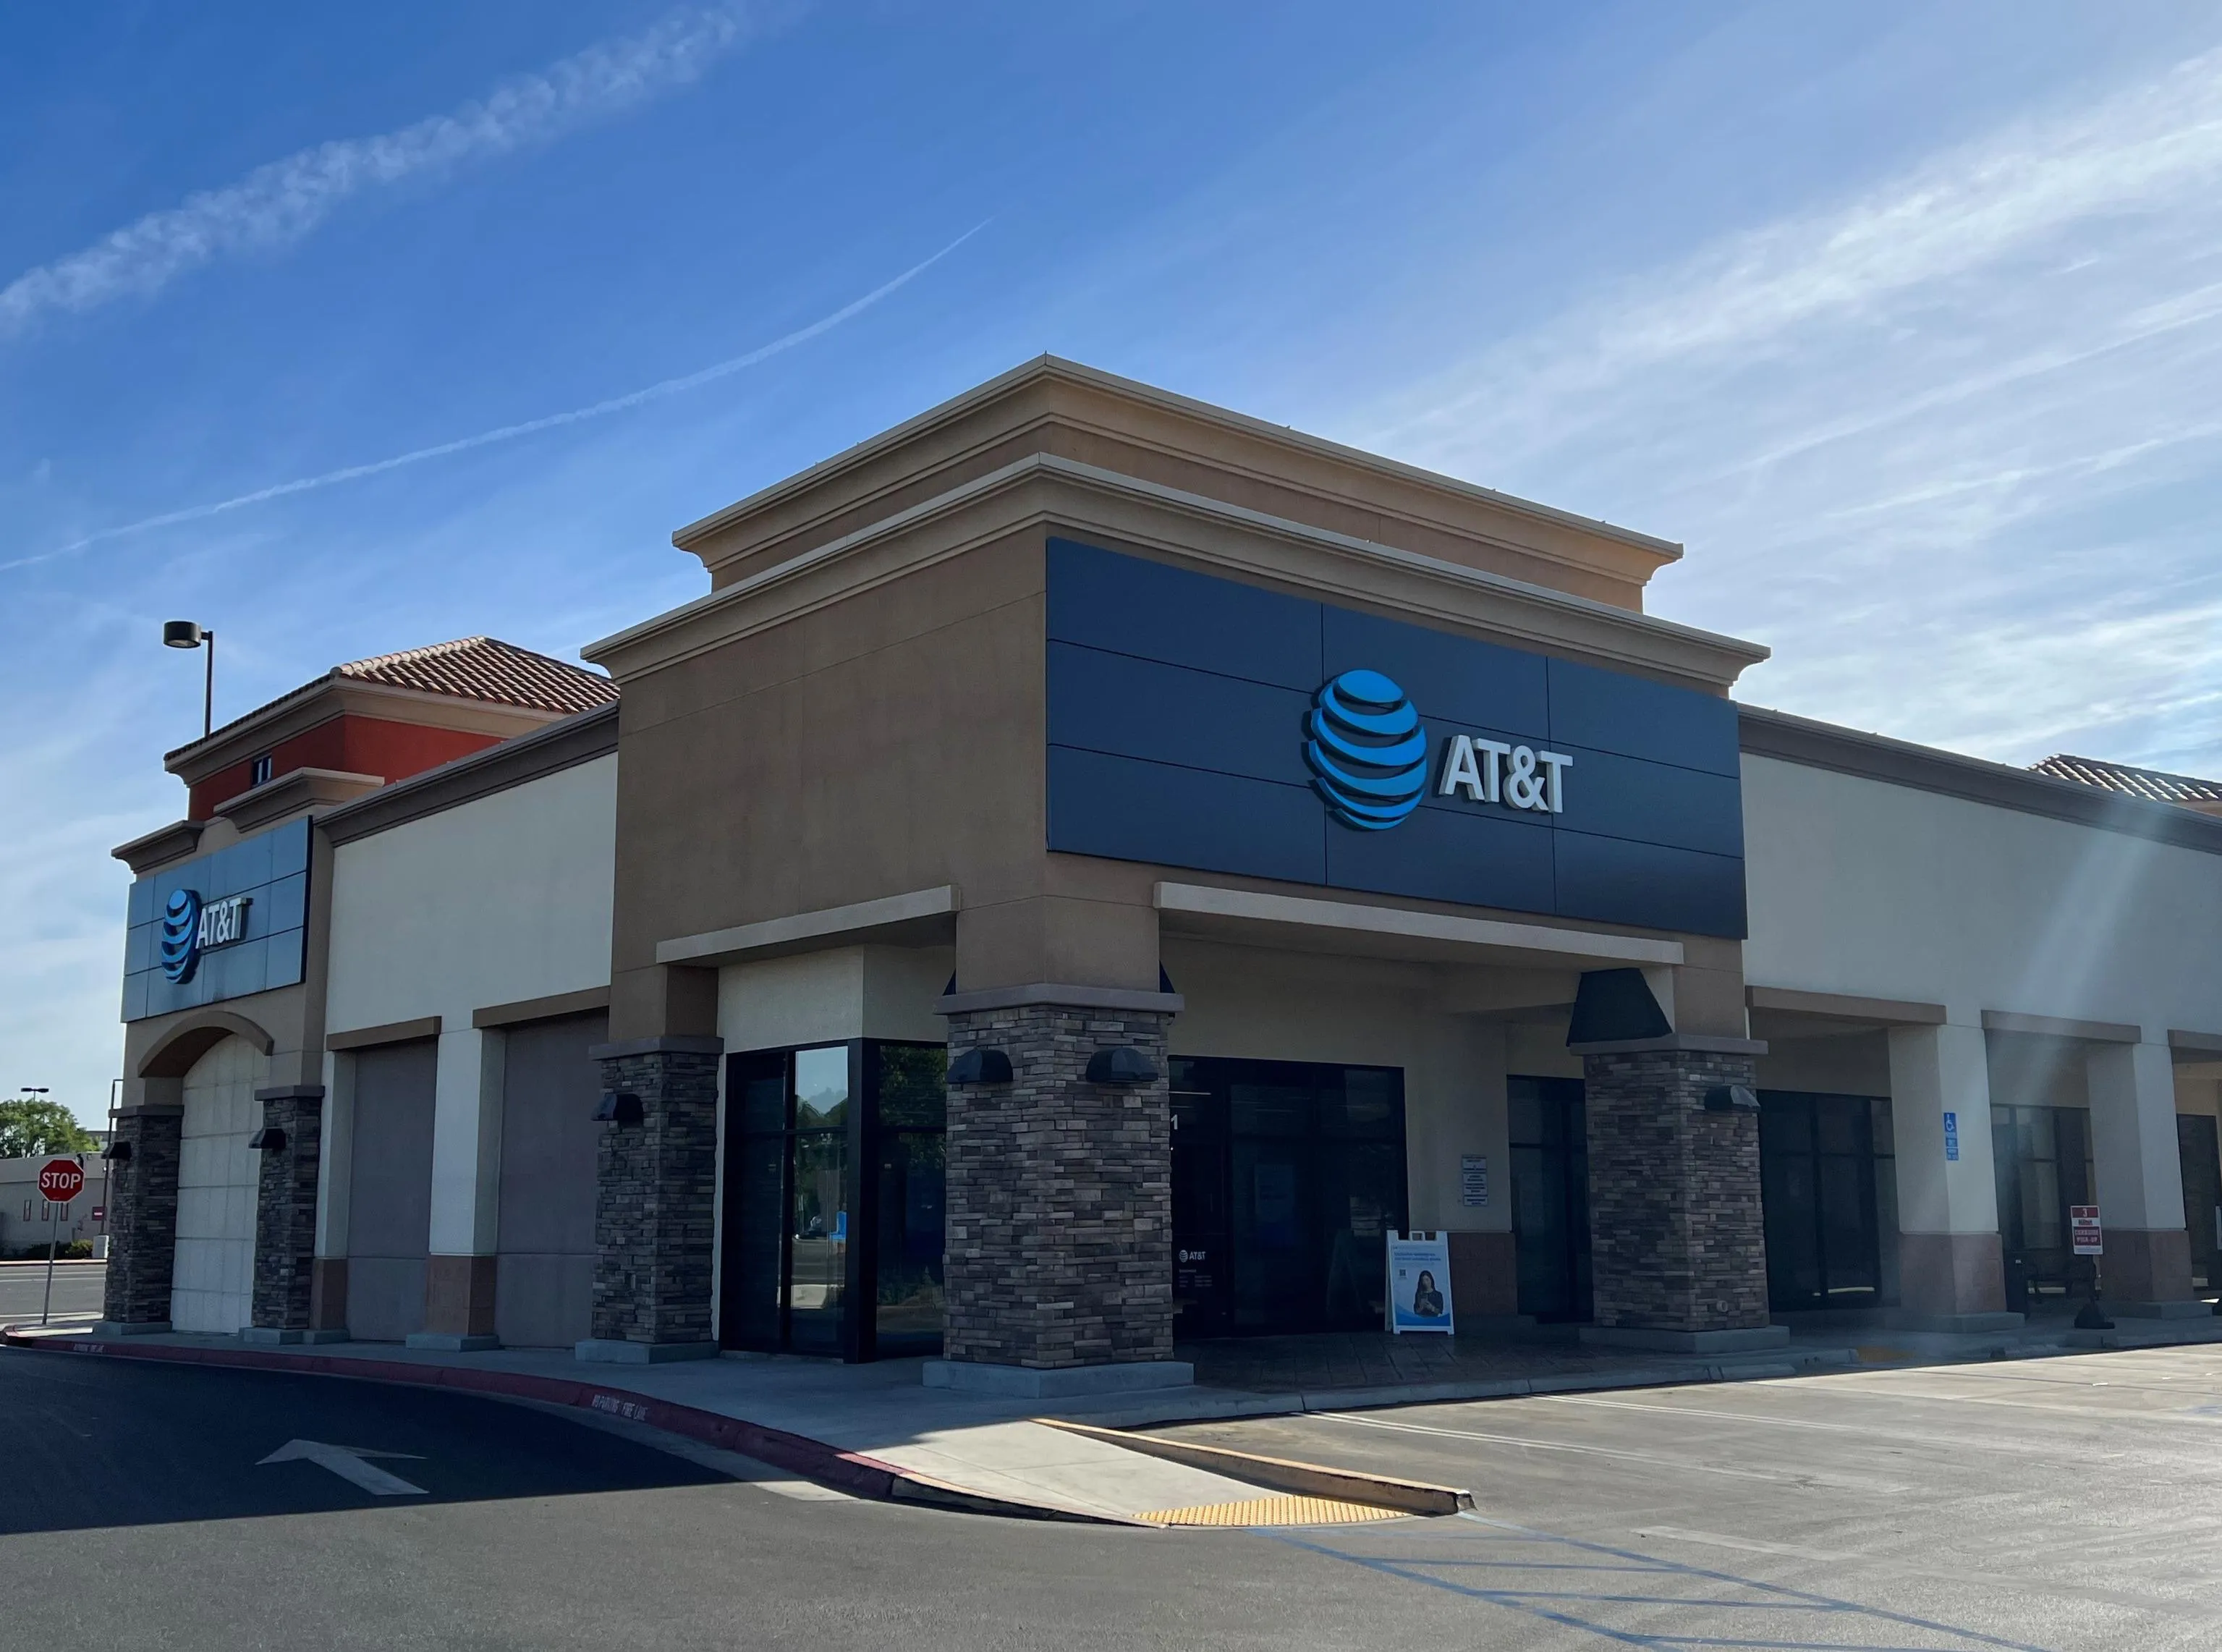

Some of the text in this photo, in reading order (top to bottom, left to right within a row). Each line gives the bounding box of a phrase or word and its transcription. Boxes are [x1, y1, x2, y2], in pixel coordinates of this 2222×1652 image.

[1439, 734, 1573, 813] AT&T
[195, 897, 242, 949] AT&T
[41, 1172, 81, 1189] STOP
[1189, 1251, 1206, 1260] AT&T
